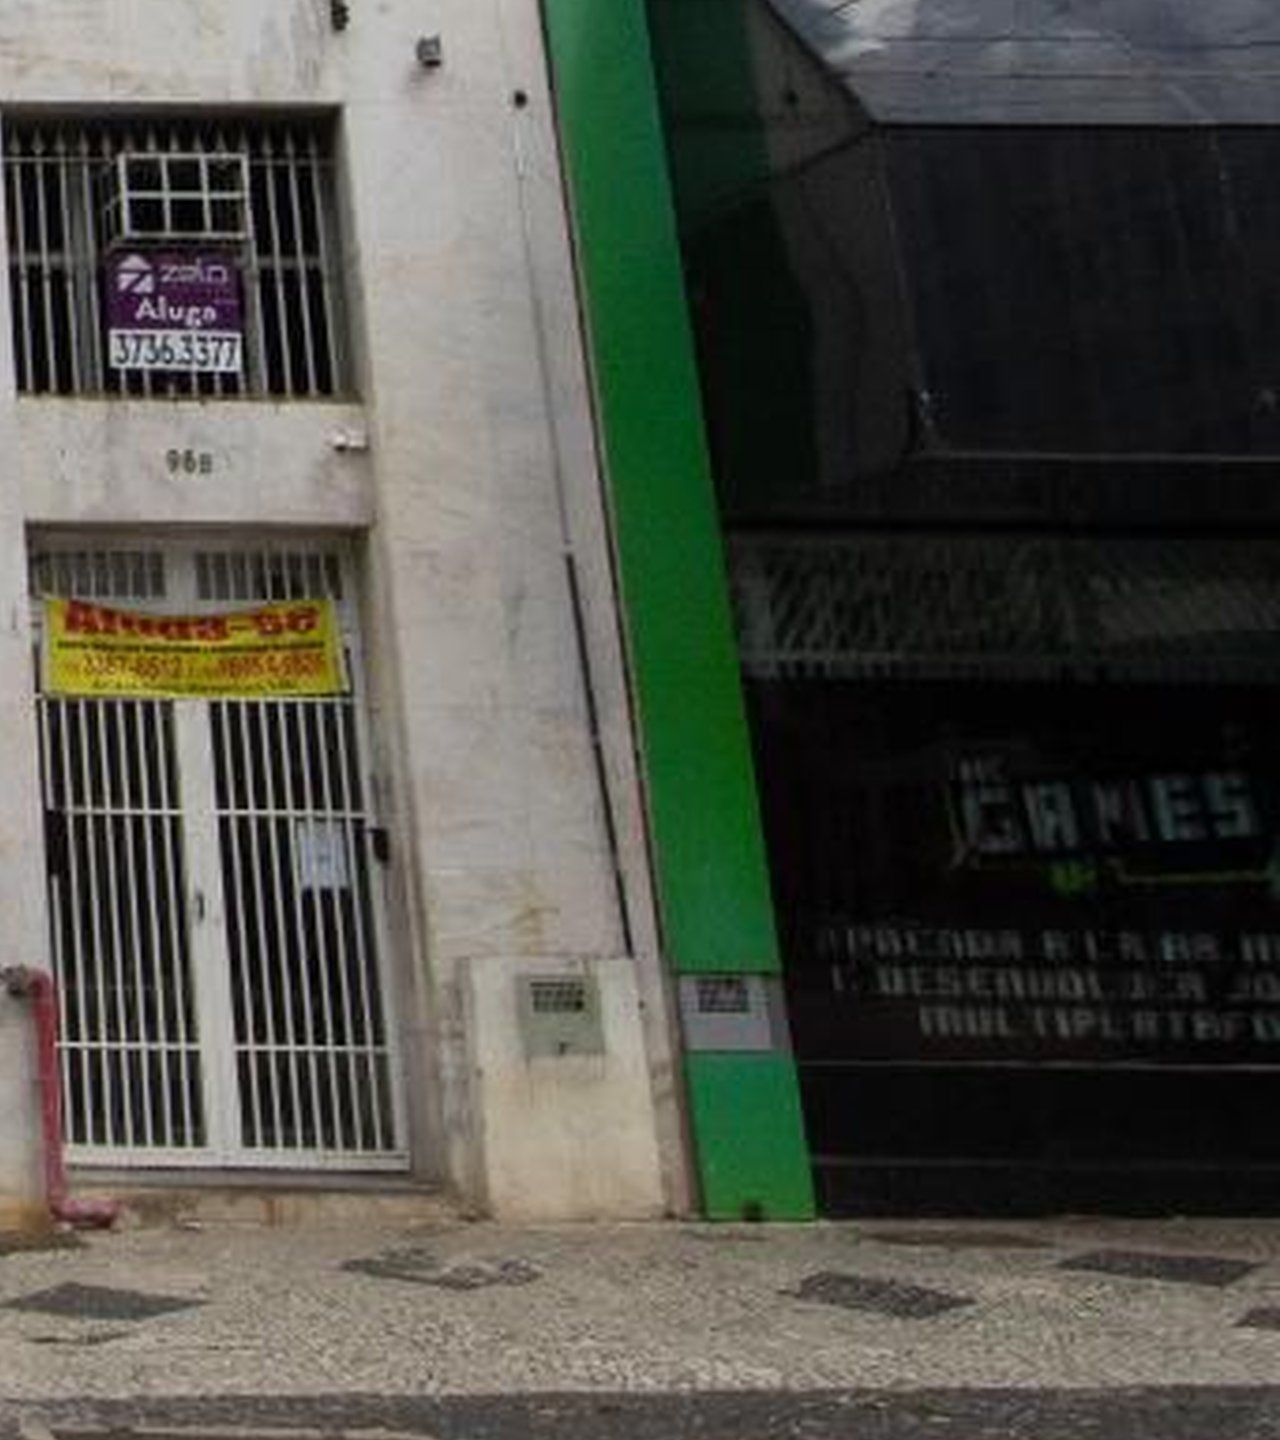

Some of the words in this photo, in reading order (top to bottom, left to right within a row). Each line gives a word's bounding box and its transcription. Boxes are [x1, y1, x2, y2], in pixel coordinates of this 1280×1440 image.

[134, 297, 218, 327] Aluga
[114, 333, 239, 367] 3736.3377
[960, 773, 1256, 855] GAMES
